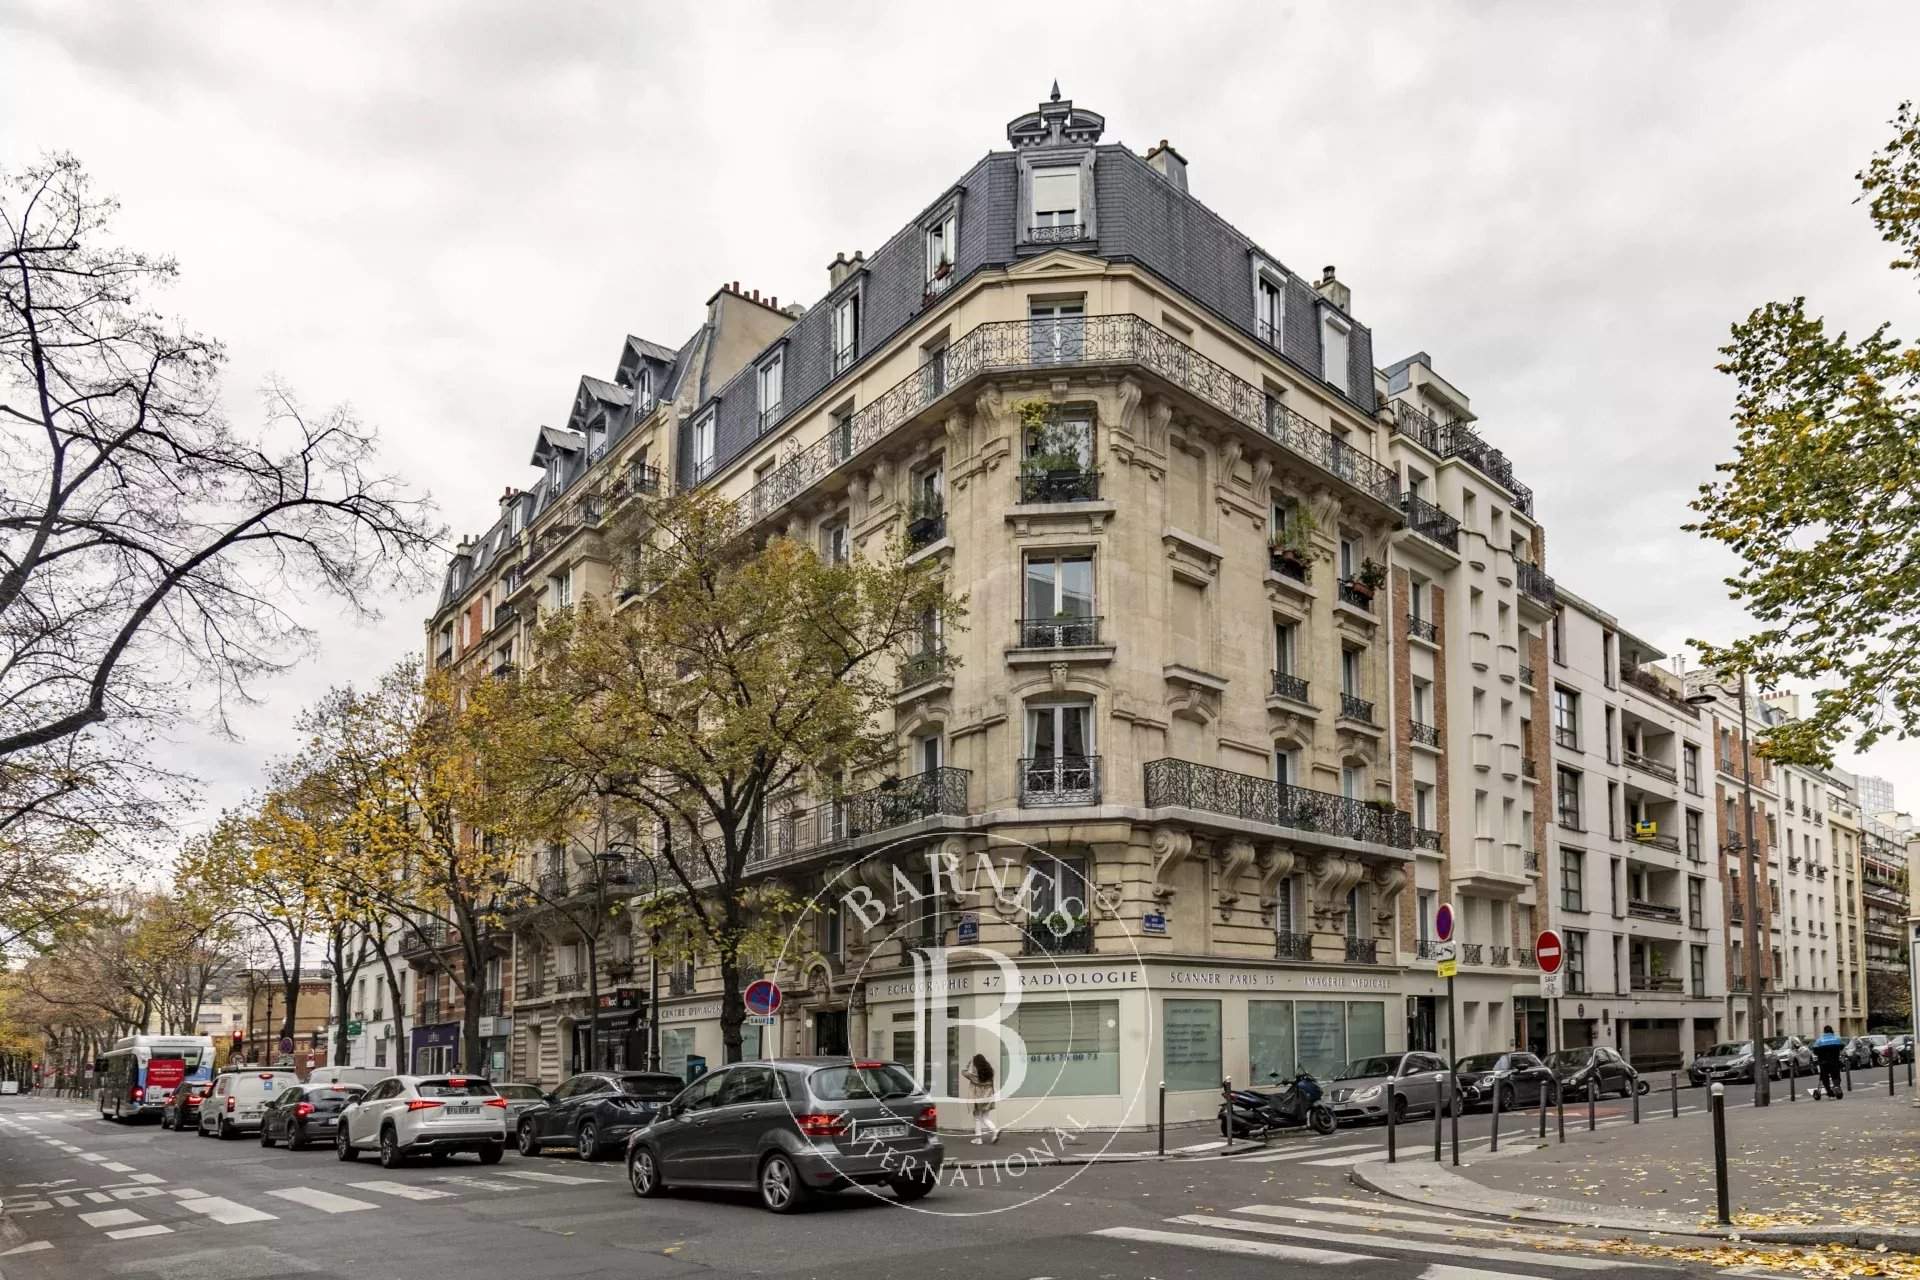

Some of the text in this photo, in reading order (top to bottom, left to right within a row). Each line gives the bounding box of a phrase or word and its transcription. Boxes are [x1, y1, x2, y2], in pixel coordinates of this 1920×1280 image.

[983, 971, 1138, 987] 47 RADIOLOGIE
[1169, 971, 1220, 984] SCANNER
[1229, 974, 1257, 985] PARIS
[1544, 975, 1558, 983] SAUF
[661, 1007, 686, 1019] CENTRE
